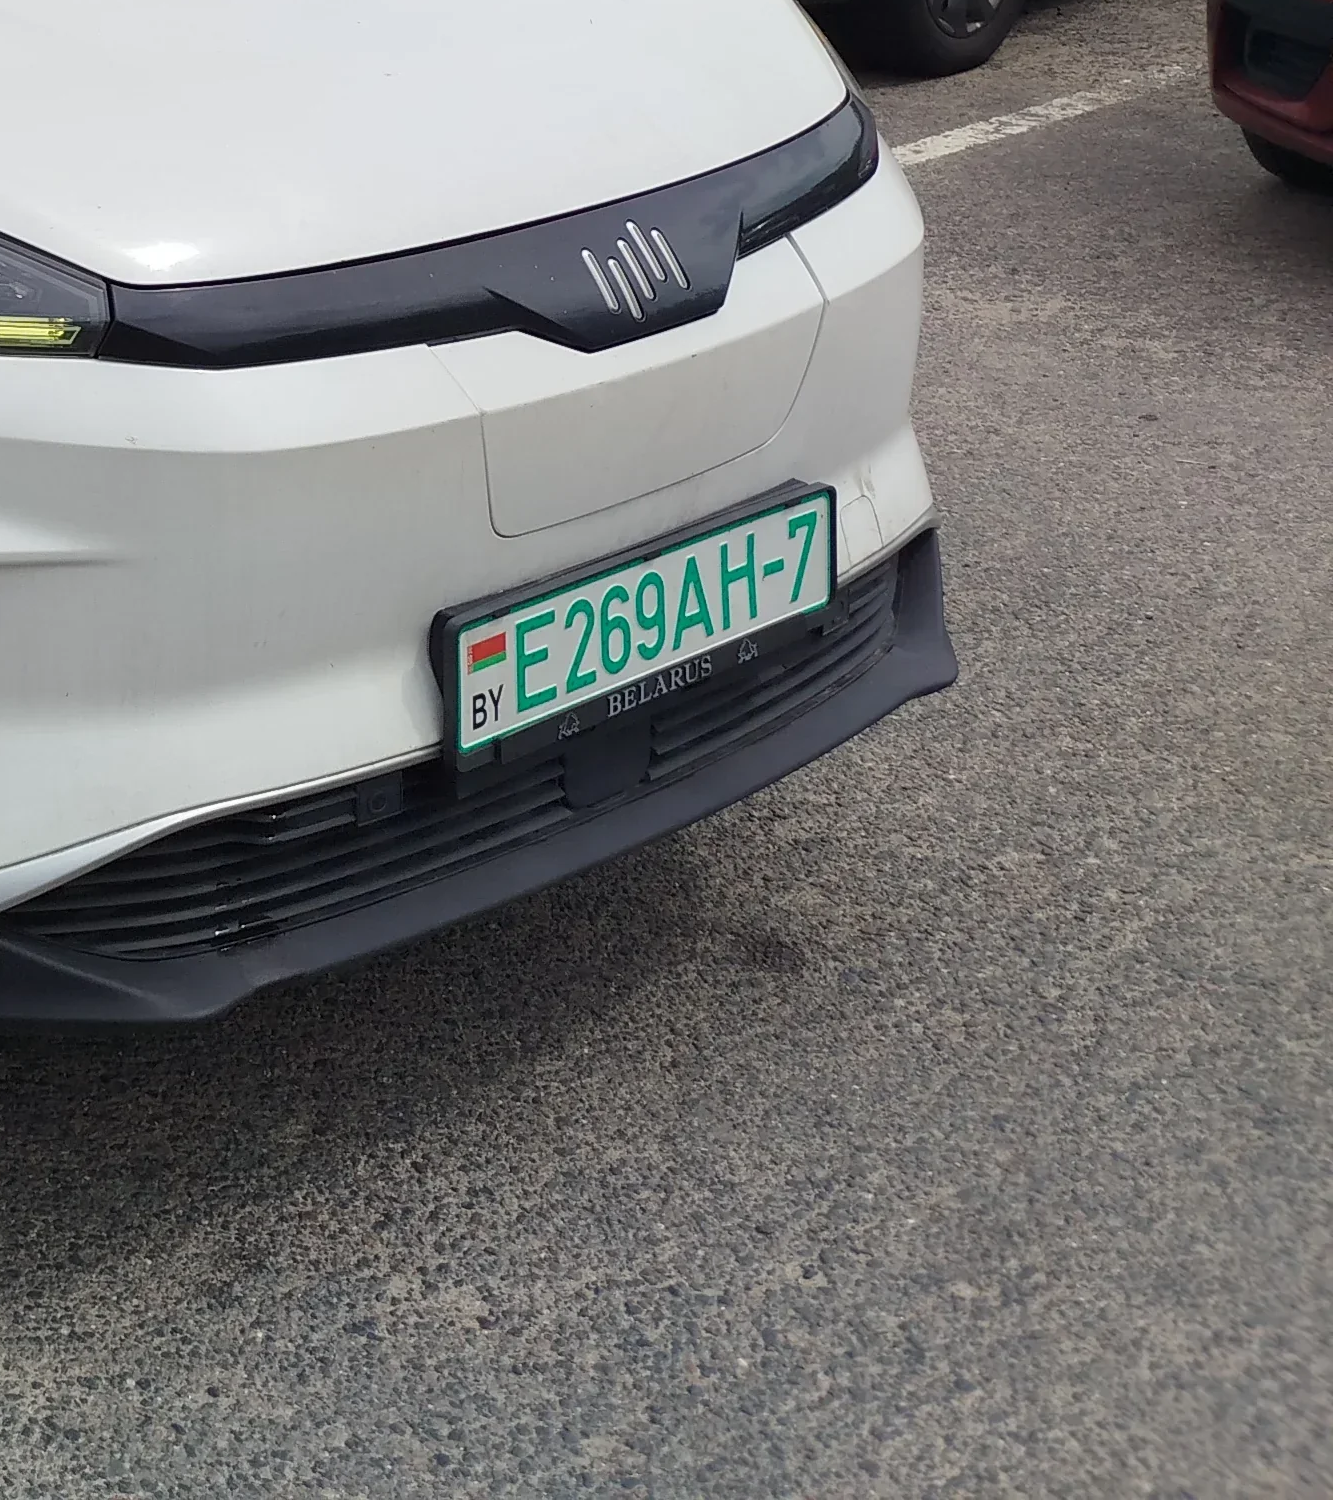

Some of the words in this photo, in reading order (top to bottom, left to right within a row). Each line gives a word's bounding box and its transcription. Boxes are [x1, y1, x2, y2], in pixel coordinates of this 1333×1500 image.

[515, 509, 818, 714] E269AH-7
[472, 683, 504, 731] BY
[607, 654, 713, 718] BELARUS
